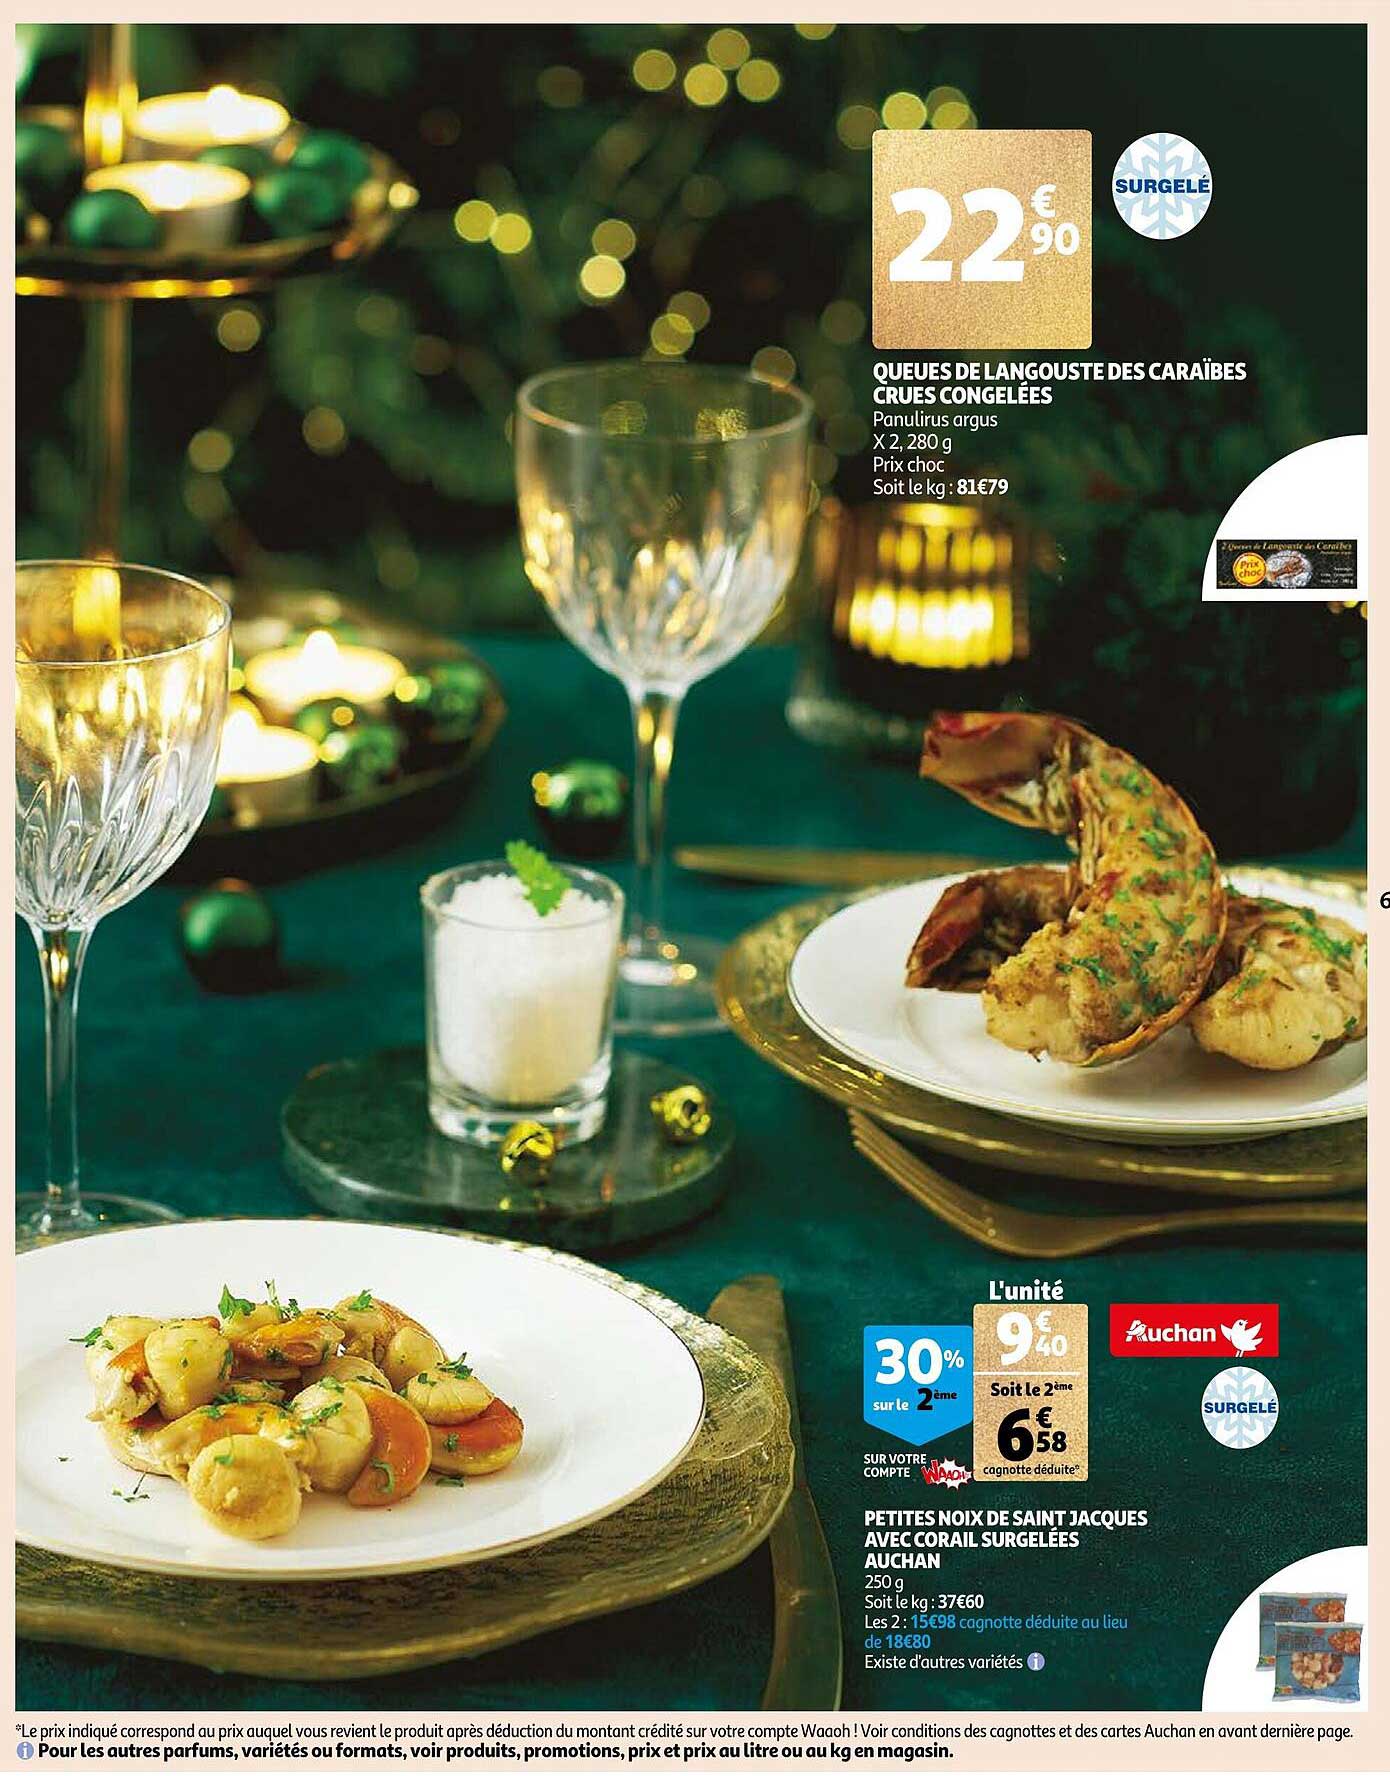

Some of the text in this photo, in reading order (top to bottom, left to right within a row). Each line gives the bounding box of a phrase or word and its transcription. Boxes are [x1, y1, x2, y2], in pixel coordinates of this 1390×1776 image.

[1115, 174, 1211, 194] SURGELÉ
[888, 186, 1025, 283] 22
[1030, 222, 1080, 256] 90
[873, 357, 1247, 385] QUEUES DE LANGOUSTE DES CARAÏBES
[873, 382, 1053, 405] CRUES CONGELÉES
[873, 410, 998, 432] Panulirus argus
[873, 433, 952, 455] X 2, 280 g
[873, 455, 945, 473] Prix choc
[873, 478, 905, 495] Soit
[908, 478, 923, 495] le
[926, 478, 946, 500] kg
[956, 478, 1009, 495] 81€79
[1238, 569, 1262, 579] choc
[1240, 559, 1260, 570] Prix
[989, 1278, 1064, 1301] L'unité
[997, 1312, 1034, 1366] 9
[1036, 1334, 1068, 1357] 40
[1125, 1319, 1217, 1342] Auchan
[990, 1381, 1022, 1397] Soit
[1025, 1381, 1041, 1397] le
[872, 1401, 894, 1411] sur
[895, 1397, 909, 1411] le
[1203, 1399, 1277, 1414] SURGELÉ
[997, 1408, 1034, 1462] 6
[1036, 1431, 1067, 1453] 58
[863, 1453, 927, 1465] SUR VOTRE
[863, 1467, 911, 1478] COMPTE
[982, 1464, 1032, 1478] cagnotte
[864, 1510, 1148, 1531] PETITES NOIX DE SAINT JACQUES
[864, 1526, 1080, 1548] AVEC CORAIL SURGELÉES
[864, 1552, 941, 1569] AUCHAN
[864, 1574, 904, 1593] 250 g
[864, 1594, 893, 1609] Soit
[895, 1593, 908, 1609] le
[911, 1594, 928, 1612] kg
[937, 1593, 985, 1609] 37€60
[865, 1614, 888, 1629] Les
[890, 1614, 900, 1629] 2
[910, 1614, 956, 1629] 15€98
[959, 1615, 1022, 1632] cagnotte
[1025, 1614, 1078, 1629] déduite
[1081, 1618, 1099, 1629] au
[1103, 1614, 1128, 1629] lieu
[864, 1633, 931, 1649] de 18€80
[865, 1653, 1024, 1669] Existe d'autres variétés
[40, 1723, 66, 1742] prix
[68, 1722, 118, 1742] indiqué
[120, 1723, 195, 1742] correspond
[198, 1727, 215, 1738] au
[218, 1723, 244, 1742] prix
[246, 1723, 293, 1742] auquel
[295, 1727, 328, 1738] vous
[330, 1723, 377, 1738] revient
[379, 1723, 392, 1738] le
[394, 1723, 444, 1742] produit
[446, 1723, 484, 1742] après
[486, 1723, 553, 1738] déduction
[555, 1723, 573, 1738] du
[576, 1724, 636, 1738] montant
[638, 1722, 684, 1738] crédité
[686, 1727, 708, 1738] sur
[709, 1724, 745, 1738] votre
[747, 1724, 799, 1742] compte
[800, 1723, 851, 1738] Waaoh
[860, 1723, 889, 1738] Voir
[891, 1723, 961, 1738] conditions
[963, 1723, 987, 1738] des
[989, 1724, 1056, 1742] cagnottes
[1058, 1724, 1073, 1738] et
[1074, 1723, 1098, 1738] des
[1100, 1724, 1142, 1738] cartes
[1143, 1723, 1196, 1738] Auchan
[1198, 1727, 1215, 1738] en
[1217, 1724, 1258, 1738] avant
[1260, 1723, 1315, 1738] dernière
[1317, 1727, 1353, 1742] page.
[38, 1741, 954, 1762] Pour les autres parfums, variétés ou formats, voir produits, promotions, prix et prix au litre ou au kg en magasin.
